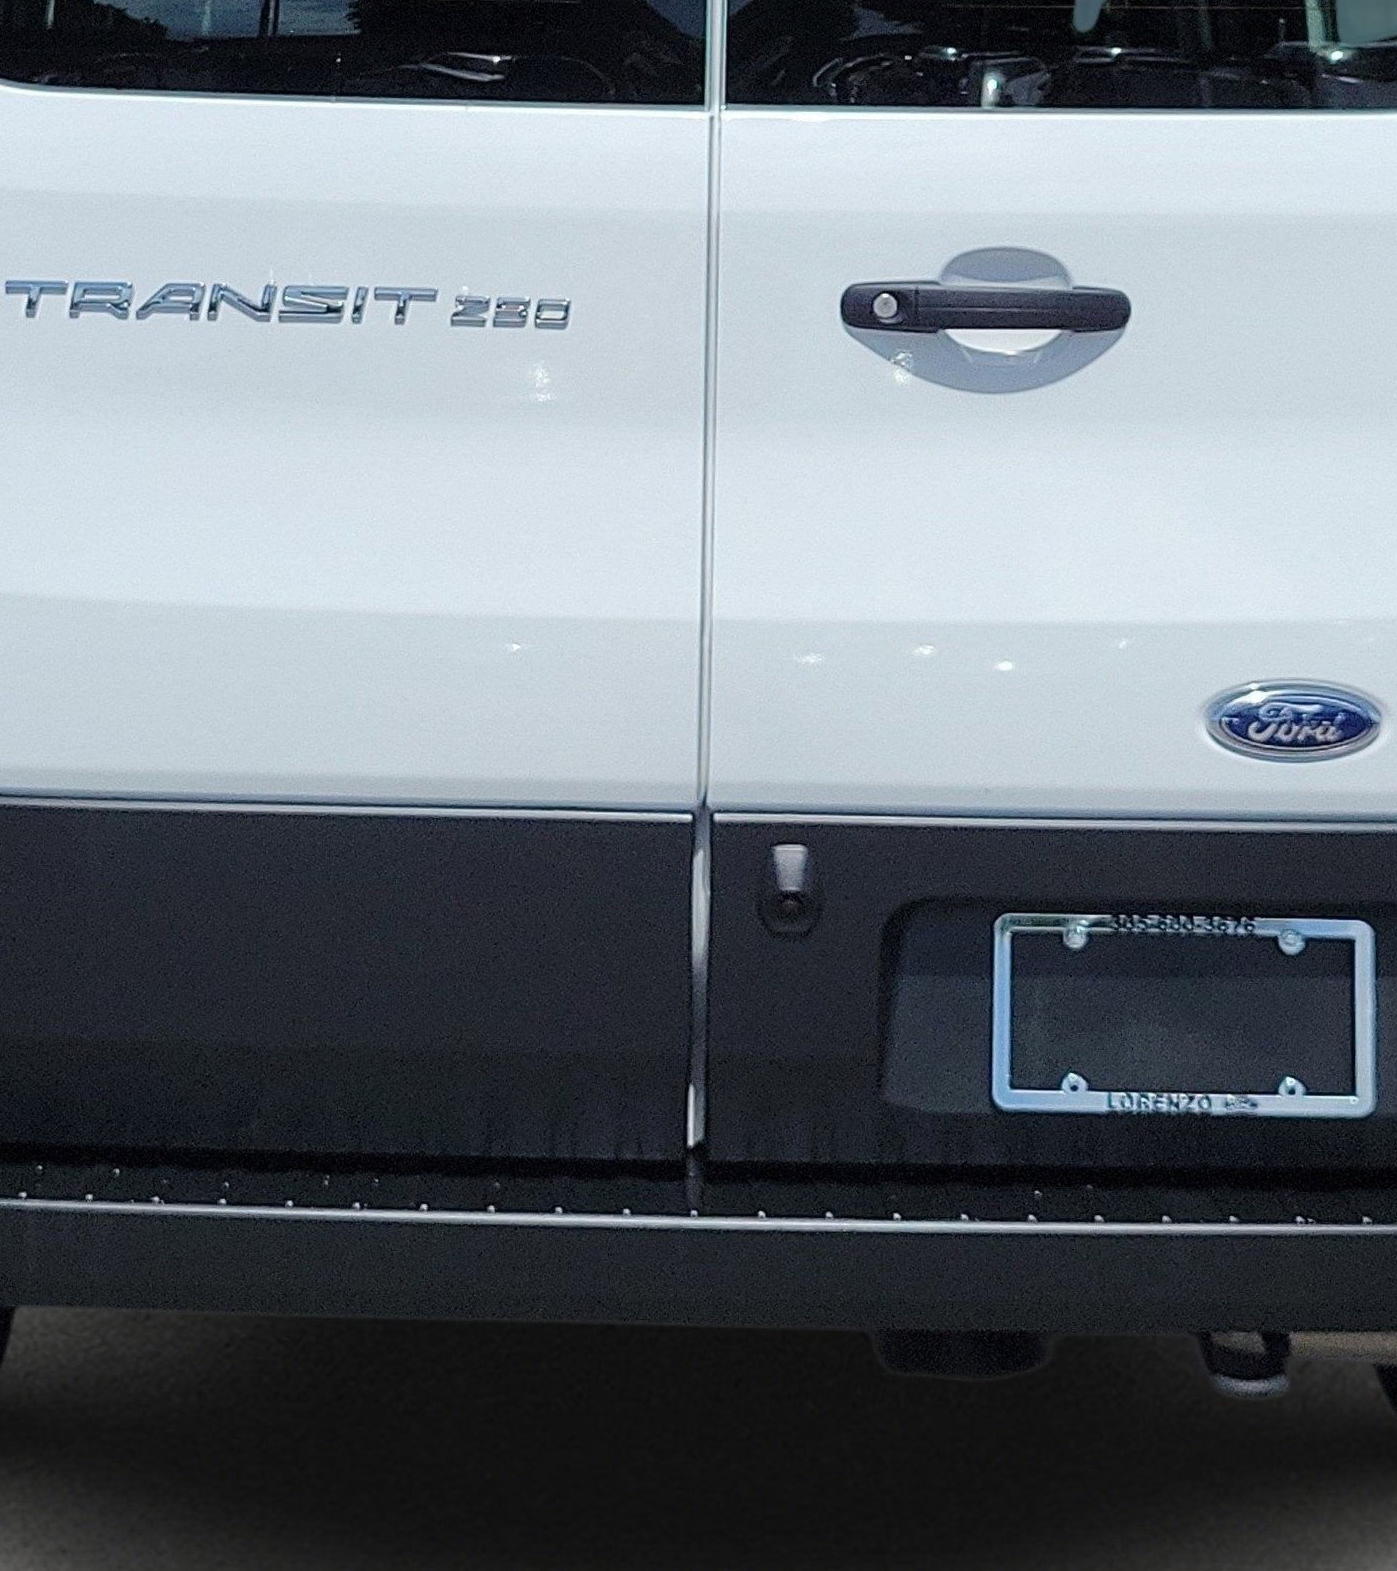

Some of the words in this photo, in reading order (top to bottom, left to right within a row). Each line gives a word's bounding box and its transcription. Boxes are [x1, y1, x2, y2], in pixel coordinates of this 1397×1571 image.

[4, 279, 440, 326] TRANSIT
[1247, 701, 1346, 745] Ford
[1106, 1091, 1212, 1114] LORENZO
